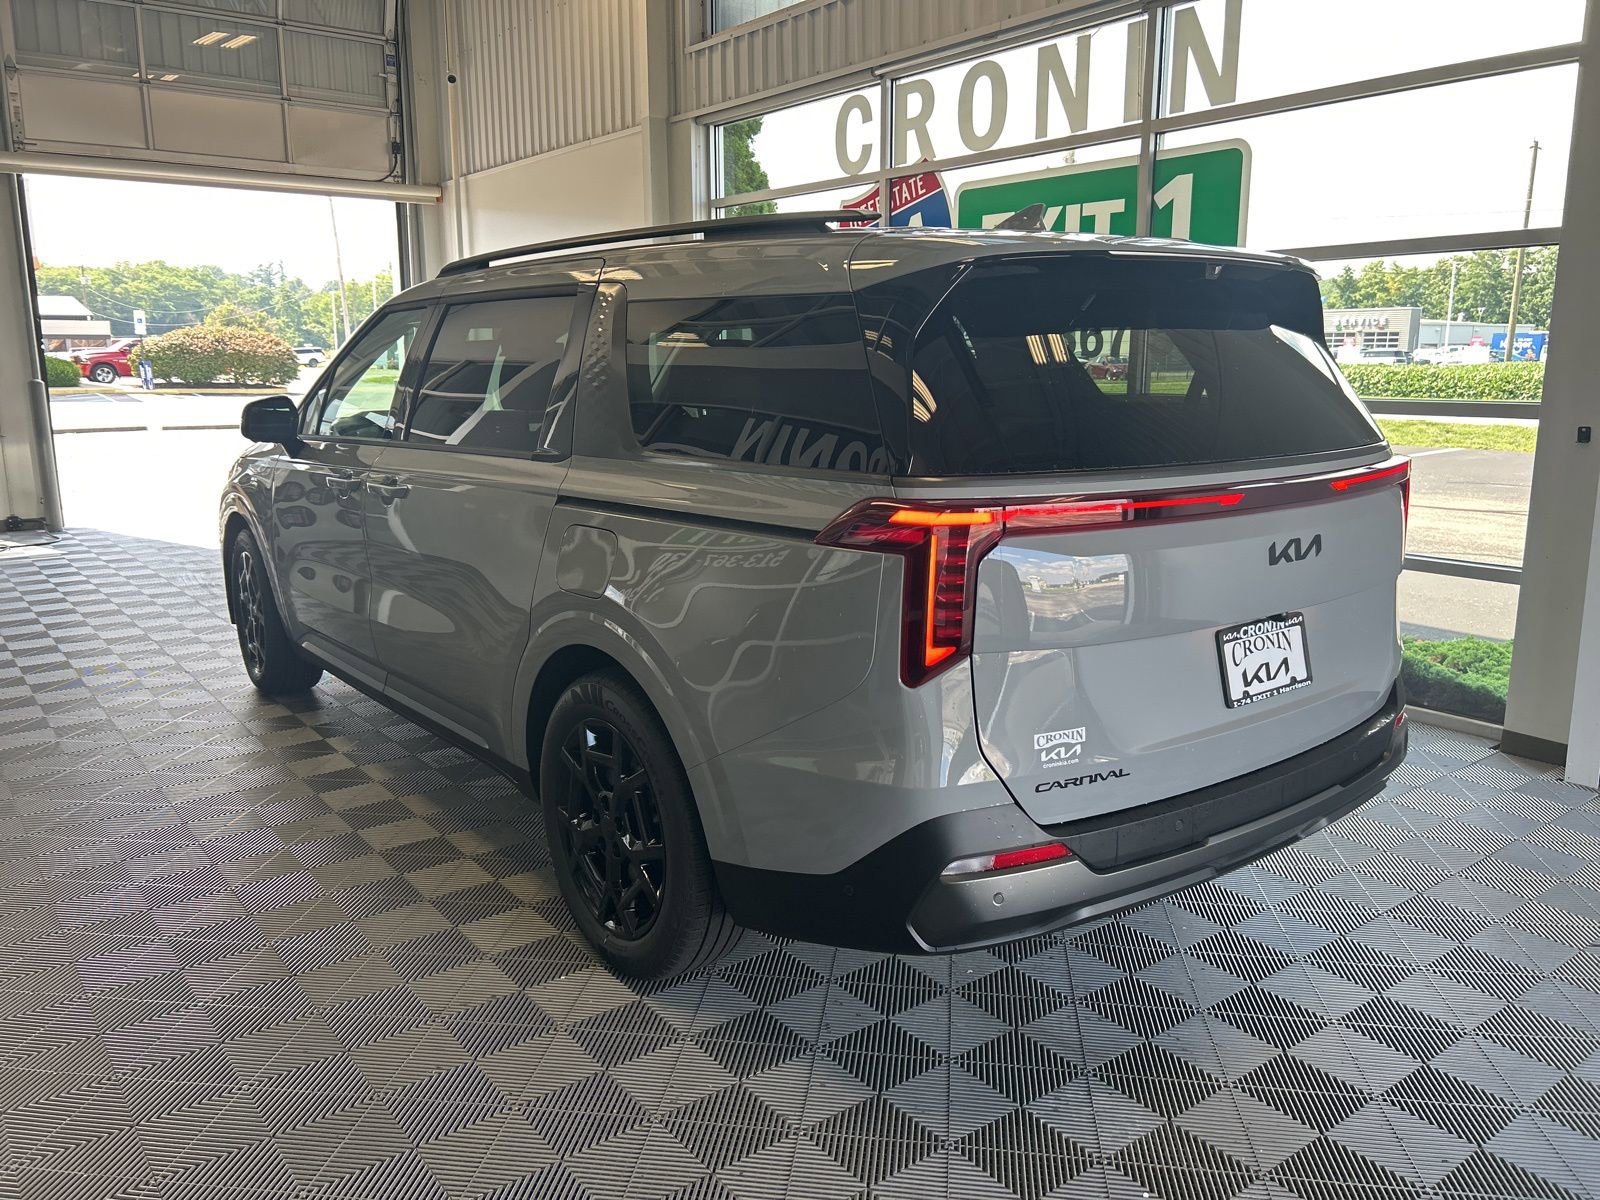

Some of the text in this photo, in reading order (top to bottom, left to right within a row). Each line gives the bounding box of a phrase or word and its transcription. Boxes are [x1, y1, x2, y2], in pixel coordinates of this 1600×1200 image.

[836, 0, 1242, 175] CRONIN
[1153, 173, 1193, 241] 1
[1268, 533, 1322, 566] KIA
[1240, 620, 1285, 639] CRONIN
[1232, 629, 1292, 667] CRONIN
[1241, 656, 1290, 688] KIA
[1233, 679, 1312, 708] I-74 EXIT 1 Harrison
[1036, 728, 1084, 748] CRONIN
[1040, 744, 1082, 762] KIA
[1042, 758, 1080, 769] croninkia.com
[1034, 767, 1131, 793] CARNIVAL
